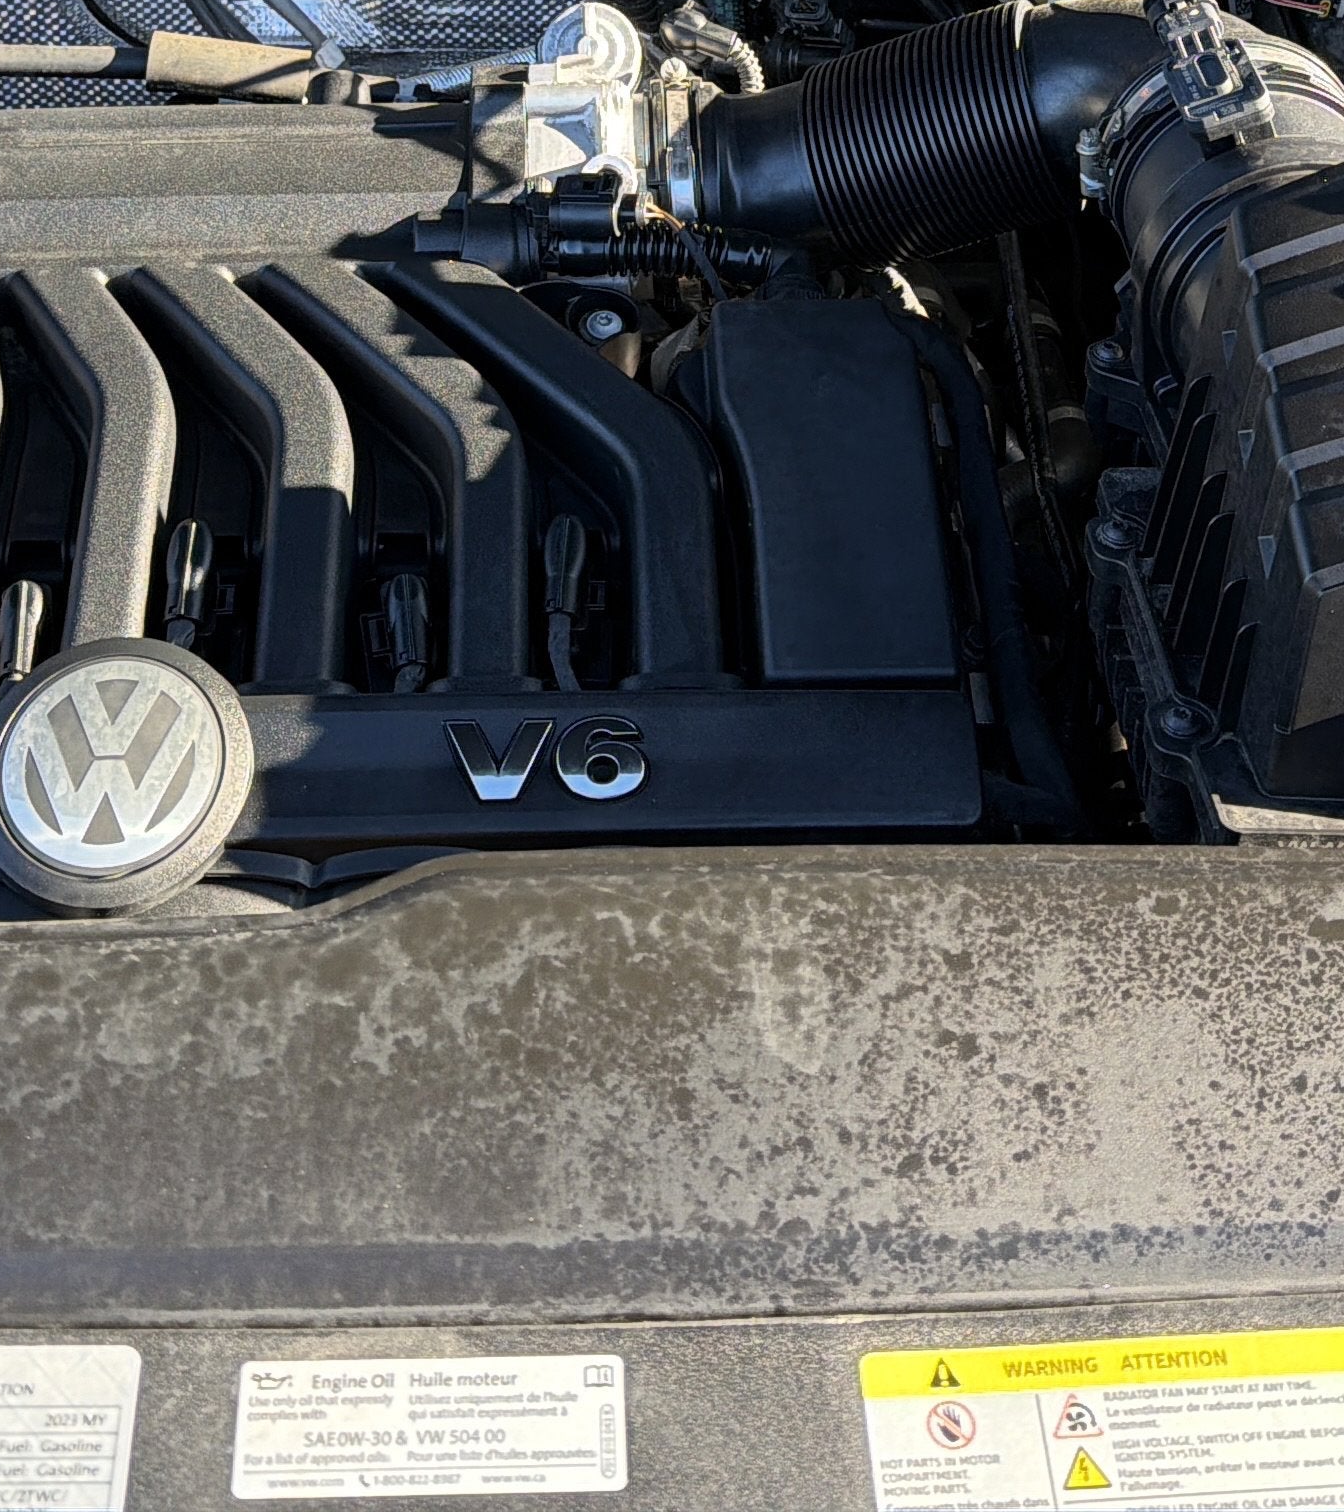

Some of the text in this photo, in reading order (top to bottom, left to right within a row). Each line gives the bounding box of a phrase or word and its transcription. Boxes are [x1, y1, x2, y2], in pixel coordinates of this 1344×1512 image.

[0, 655, 223, 875] VW
[443, 715, 650, 802] V6
[1002, 1349, 1228, 1378] WARNING ATTENTION
[311, 1373, 396, 1394] Engine Oil
[409, 1372, 519, 1388] Huile moteur
[526, 1391, 541, 1403] de
[1103, 1389, 1159, 1402] RADIATOR
[1161, 1387, 1184, 1399] FAN
[1186, 1386, 1209, 1397] MAY
[1213, 1384, 1245, 1396] START
[1247, 1383, 1260, 1393] AT
[1263, 1381, 1284, 1392] ANY
[272, 1396, 297, 1409] only
[315, 1394, 339, 1406] that
[1106, 1407, 1120, 1418] Le
[1186, 1402, 1200, 1412] de
[1285, 1398, 1298, 1407] se
[82, 1413, 108, 1426] MY
[301, 1409, 328, 1420] with
[395, 1431, 408, 1446] &
[416, 1429, 445, 1445] VW
[449, 1429, 480, 1444] 504
[484, 1428, 506, 1443] 00
[1112, 1438, 1141, 1450] HIGH
[1197, 1433, 1240, 1445] SWITCH
[1242, 1431, 1263, 1442] OFF
[1266, 1429, 1306, 1441] ENGINE
[40, 1438, 103, 1453] Gasoline
[265, 1455, 273, 1465] a
[295, 1452, 309, 1464] of
[310, 1452, 365, 1466] approved
[880, 1453, 1001, 1469] HOT PARTS IN MOTOR
[1115, 1450, 1166, 1463] IGNITION
[36, 1463, 100, 1478] Gasoline
[1118, 1468, 1153, 1478] Haute
[884, 1485, 931, 1497] MOVING
[1263, 1497, 1288, 1509] CAN
[1289, 1494, 1337, 1507] DAMAGE
